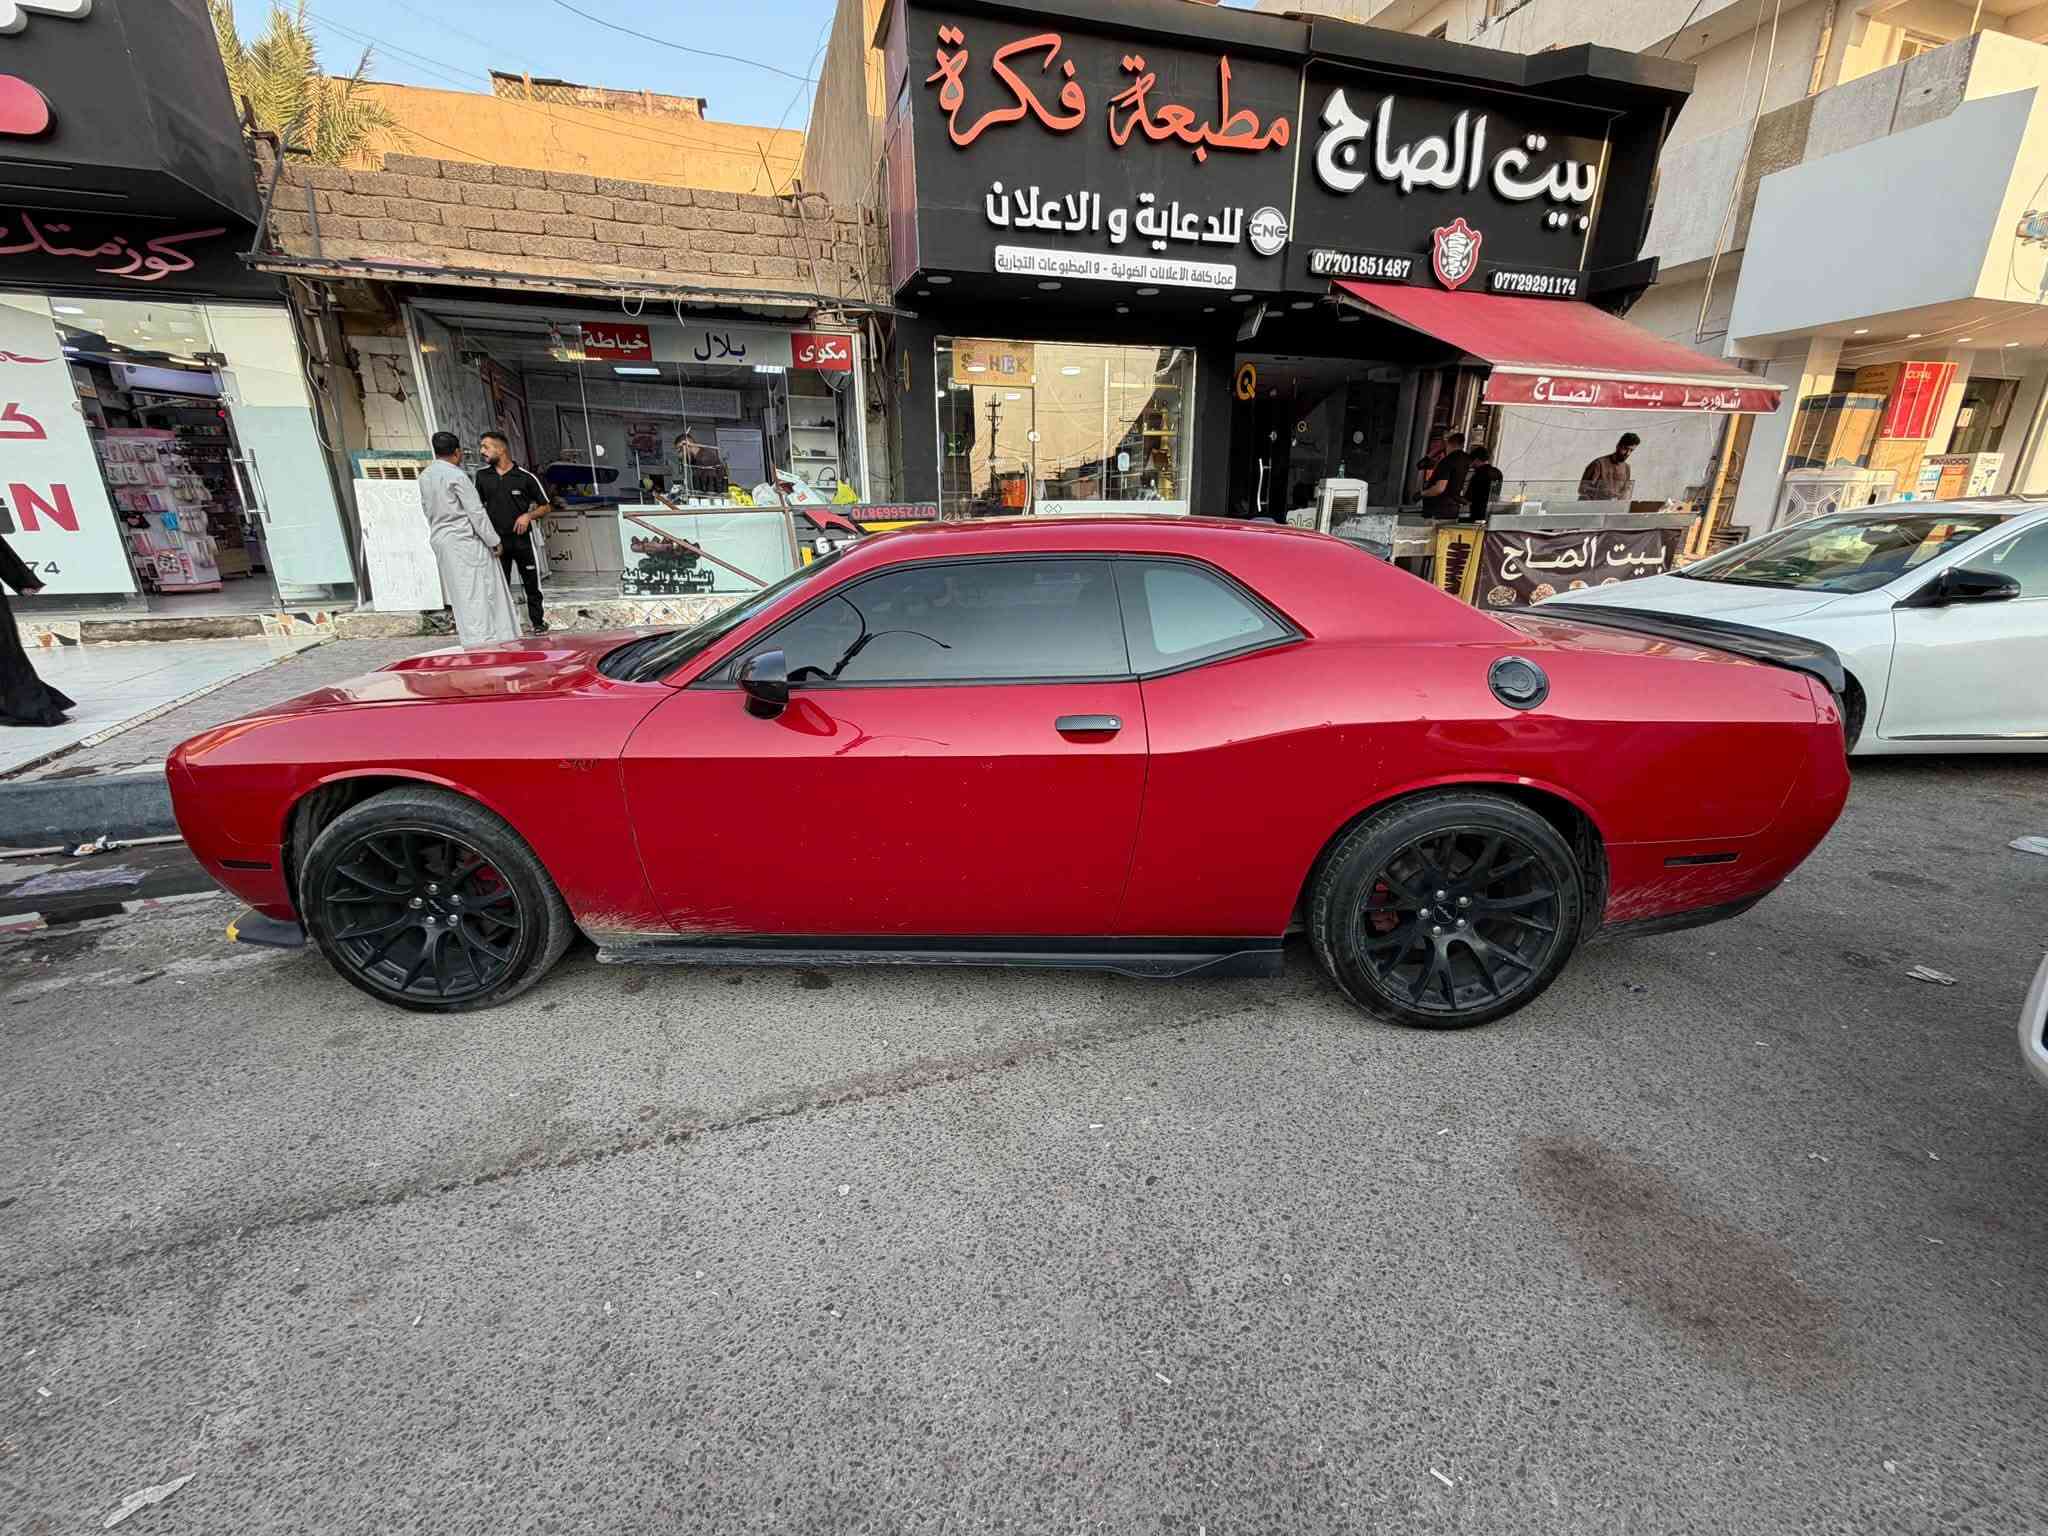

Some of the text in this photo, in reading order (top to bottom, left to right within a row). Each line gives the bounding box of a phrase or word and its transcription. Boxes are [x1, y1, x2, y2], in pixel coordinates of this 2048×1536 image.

[927, 26, 1290, 162] مطبعة فكرة
[1316, 88, 1597, 230] بيت الصاج
[986, 181, 1243, 251] للدعاية و الاعلان
[997, 253, 1035, 270] التجارية
[1190, 268, 1212, 284] كافة
[1313, 250, 1411, 279] 07701851487
[1213, 271, 1233, 286] عمل
[1494, 271, 1577, 296] 07729291174
[581, 330, 649, 354] خياطة
[693, 331, 747, 362] بلال
[1532, 375, 1601, 404] الصاج
[1681, 389, 1742, 410] شاورما
[1500, 534, 1667, 582] بيت الصاج
